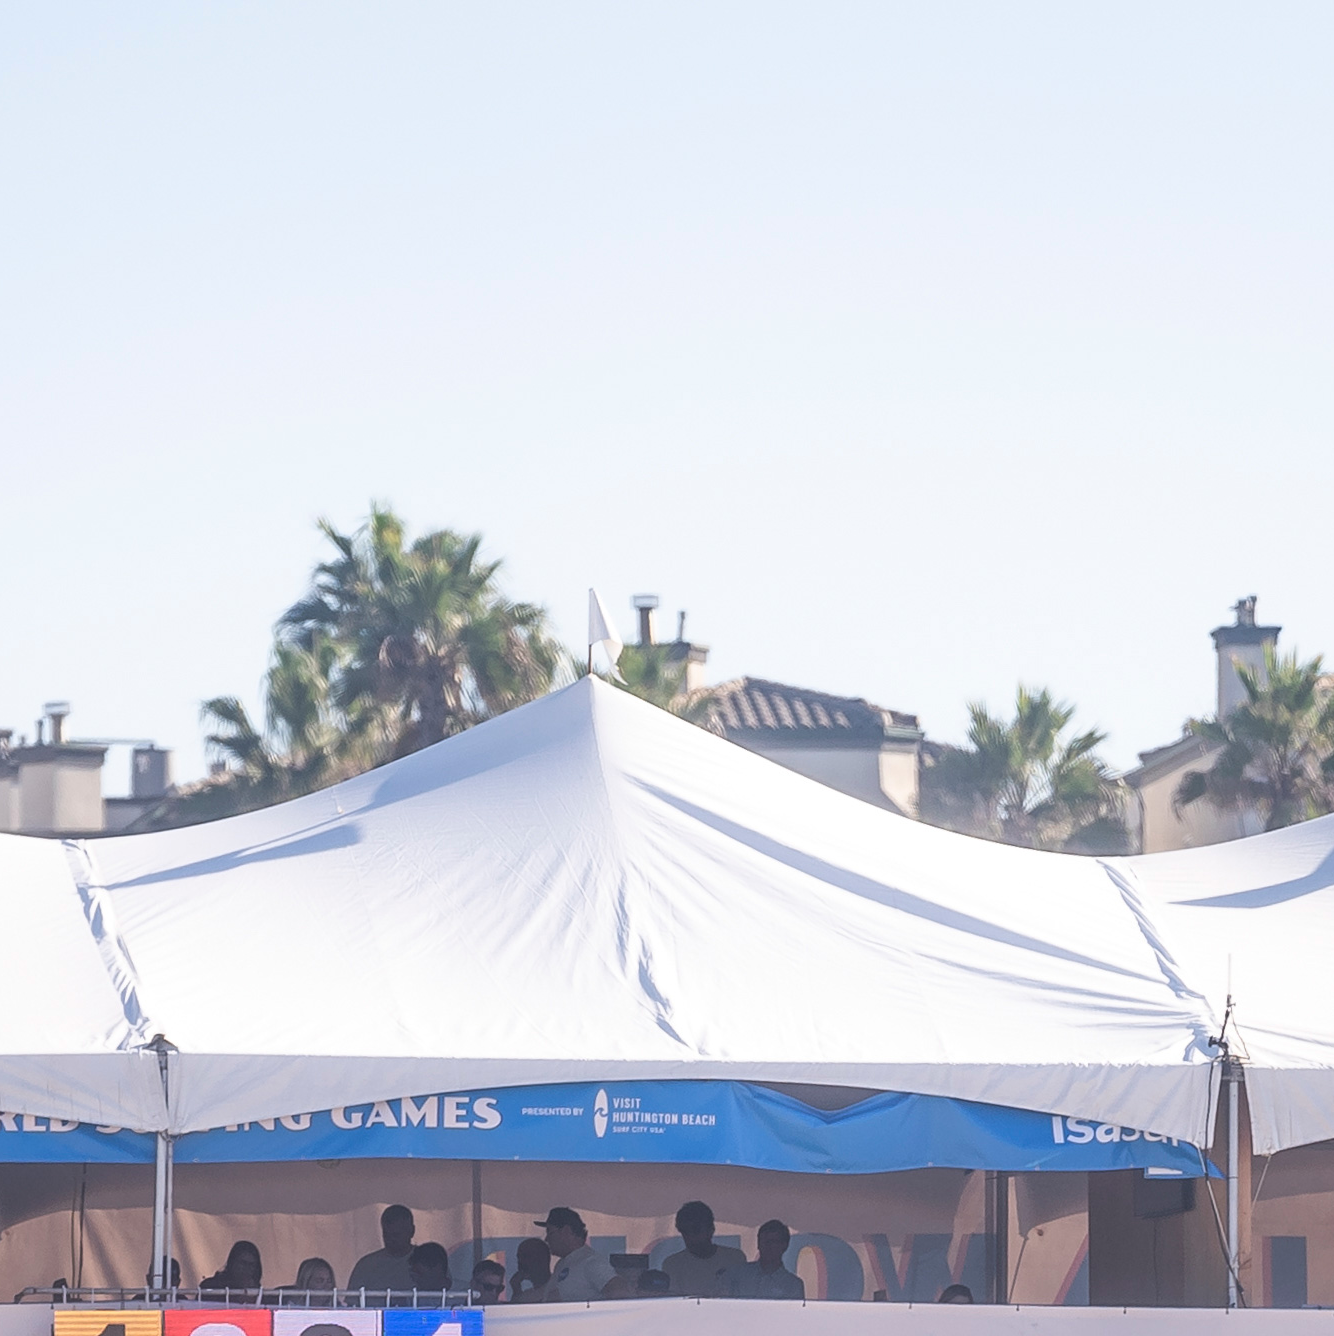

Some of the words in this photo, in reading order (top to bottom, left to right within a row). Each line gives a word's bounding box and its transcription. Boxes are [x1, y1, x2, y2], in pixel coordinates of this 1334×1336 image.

[612, 1097, 641, 1110] VISIT
[330, 1096, 503, 1131] GAMES
[521, 1107, 572, 1117] PRESENTED
[573, 1107, 584, 1117] BY
[612, 1111, 679, 1125] HUNTINGTON
[682, 1113, 716, 1126] BEACH
